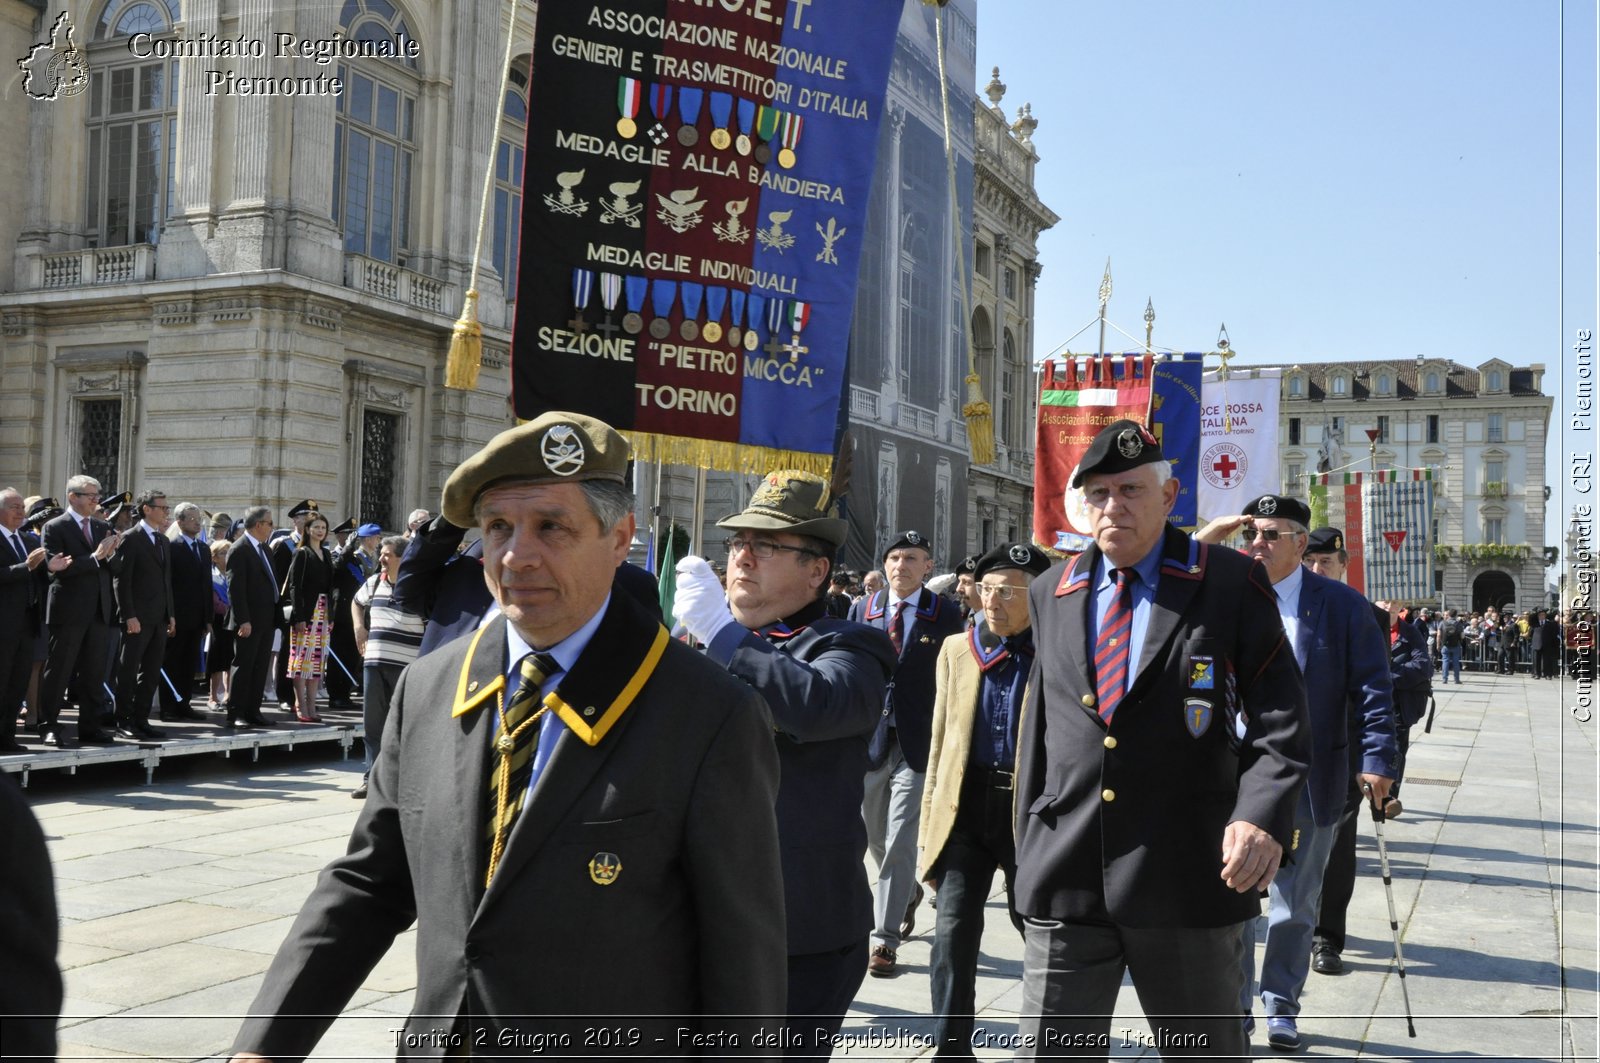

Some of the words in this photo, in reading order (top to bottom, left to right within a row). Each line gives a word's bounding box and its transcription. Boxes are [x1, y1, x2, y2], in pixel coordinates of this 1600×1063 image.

[588, 6, 737, 51] ASSOCIAZIONE
[744, 37, 847, 80] NAZIONALE
[552, 35, 623, 67] GENIERI
[631, 53, 643, 72] E
[653, 54, 793, 103] TRASMETTITORI
[800, 89, 868, 120] D'ITALIA
[555, 129, 671, 167] MEDAGLIE
[683, 153, 740, 180] ALLA
[748, 165, 845, 205] BANDIERA
[586, 242, 692, 274] MEDAGLIE
[700, 259, 798, 295] INDIVIDUALI
[537, 326, 636, 362] SEZIONE
[648, 341, 738, 375] "PIETRO
[743, 357, 825, 388] MICCA"
[635, 383, 738, 417] TORINO
[1201, 405, 1220, 417] OCE
[1225, 402, 1264, 415] ROSSA
